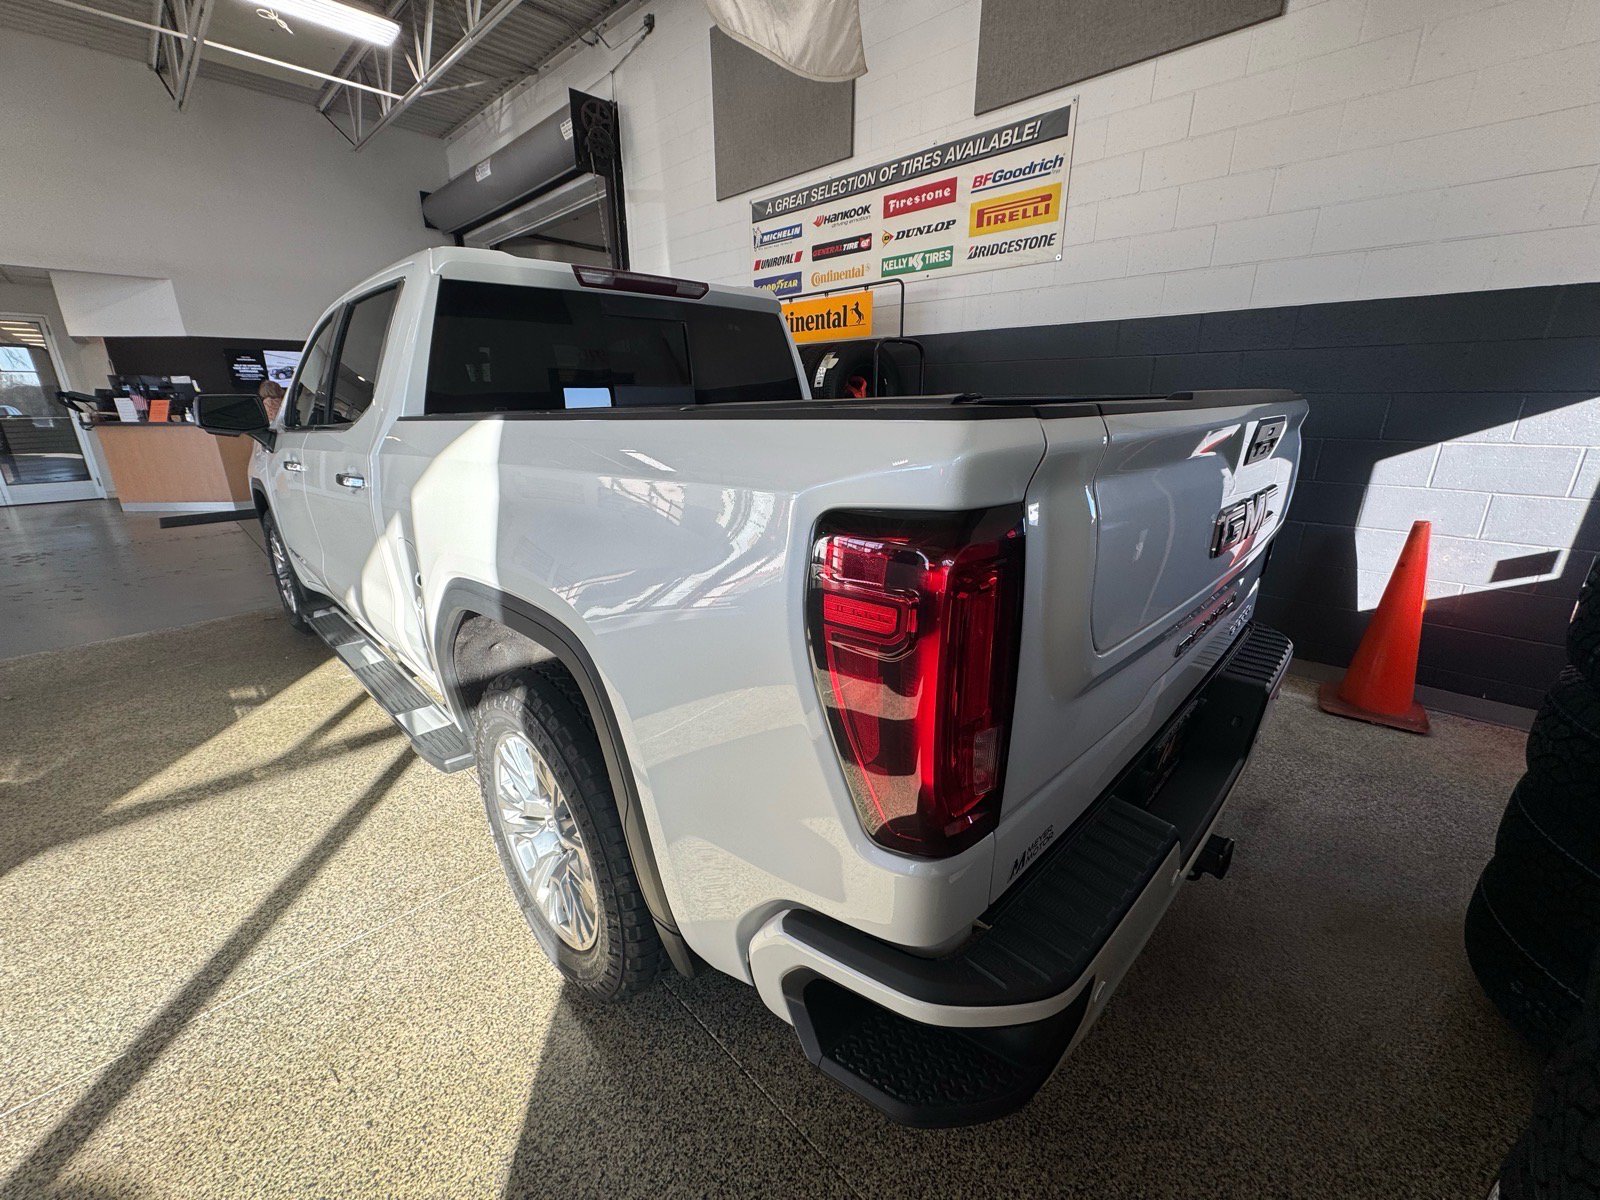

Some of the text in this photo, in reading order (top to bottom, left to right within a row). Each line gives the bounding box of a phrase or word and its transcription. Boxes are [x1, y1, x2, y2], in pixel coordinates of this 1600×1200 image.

[766, 120, 1042, 215] A GREAT SELECTION OF TIRES AVAILABLE!
[972, 154, 1065, 189] BFGoodrich
[888, 187, 951, 213] Firestone
[976, 193, 1053, 228] PIRELLI
[762, 226, 801, 242] MICHELIN
[894, 219, 957, 241] DUNLOP
[966, 233, 1057, 260] BRIDGESTONE
[760, 253, 795, 270] UNIROYAL
[882, 257, 909, 272] KELLY
[924, 249, 952, 264] TIRES
[811, 264, 865, 288] Continental
[1212, 484, 1279, 556] GMC
